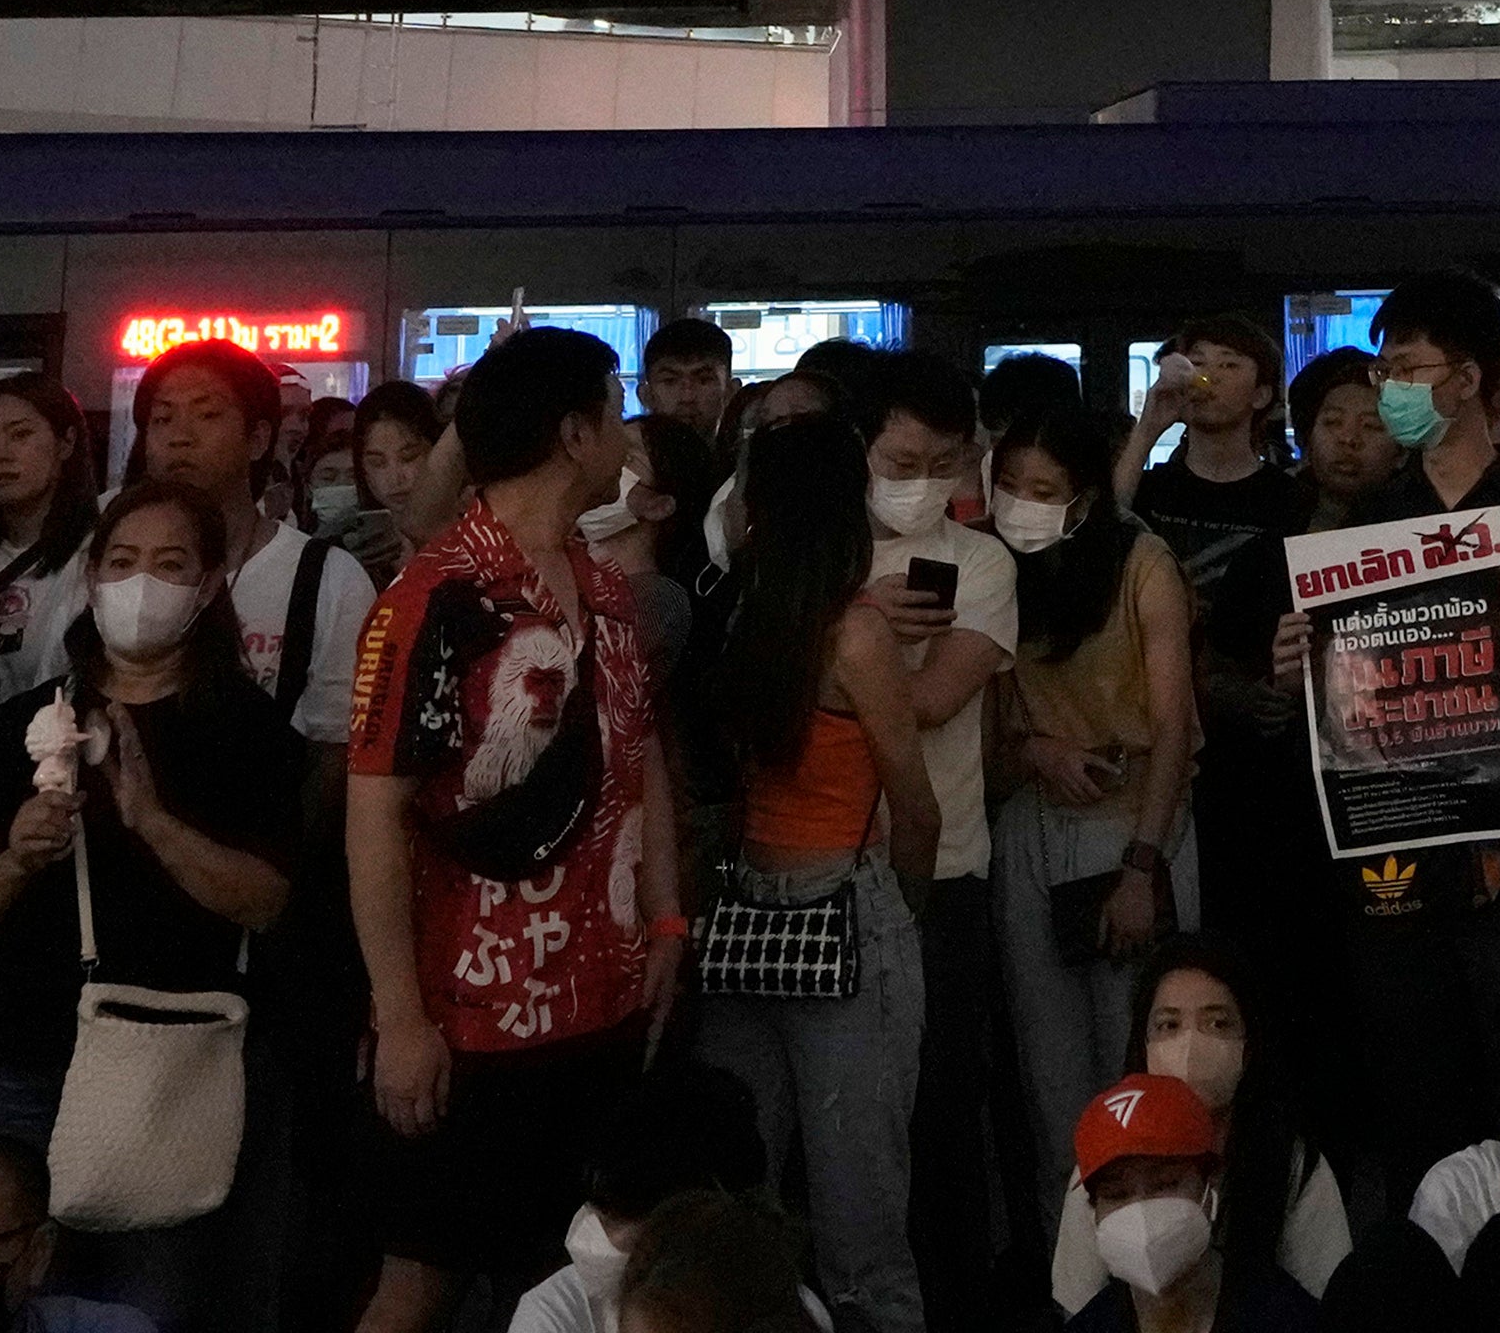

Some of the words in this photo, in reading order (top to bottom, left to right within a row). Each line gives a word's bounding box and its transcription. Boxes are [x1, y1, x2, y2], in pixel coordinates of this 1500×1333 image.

[1295, 548, 1416, 599] ยกเลิก
[1331, 597, 1488, 634] แต่งตั้งพวกพ้อง
[351, 607, 394, 732] CURVES
[1341, 684, 1499, 732] ประชาชน
[1364, 899, 1424, 917] adidas
